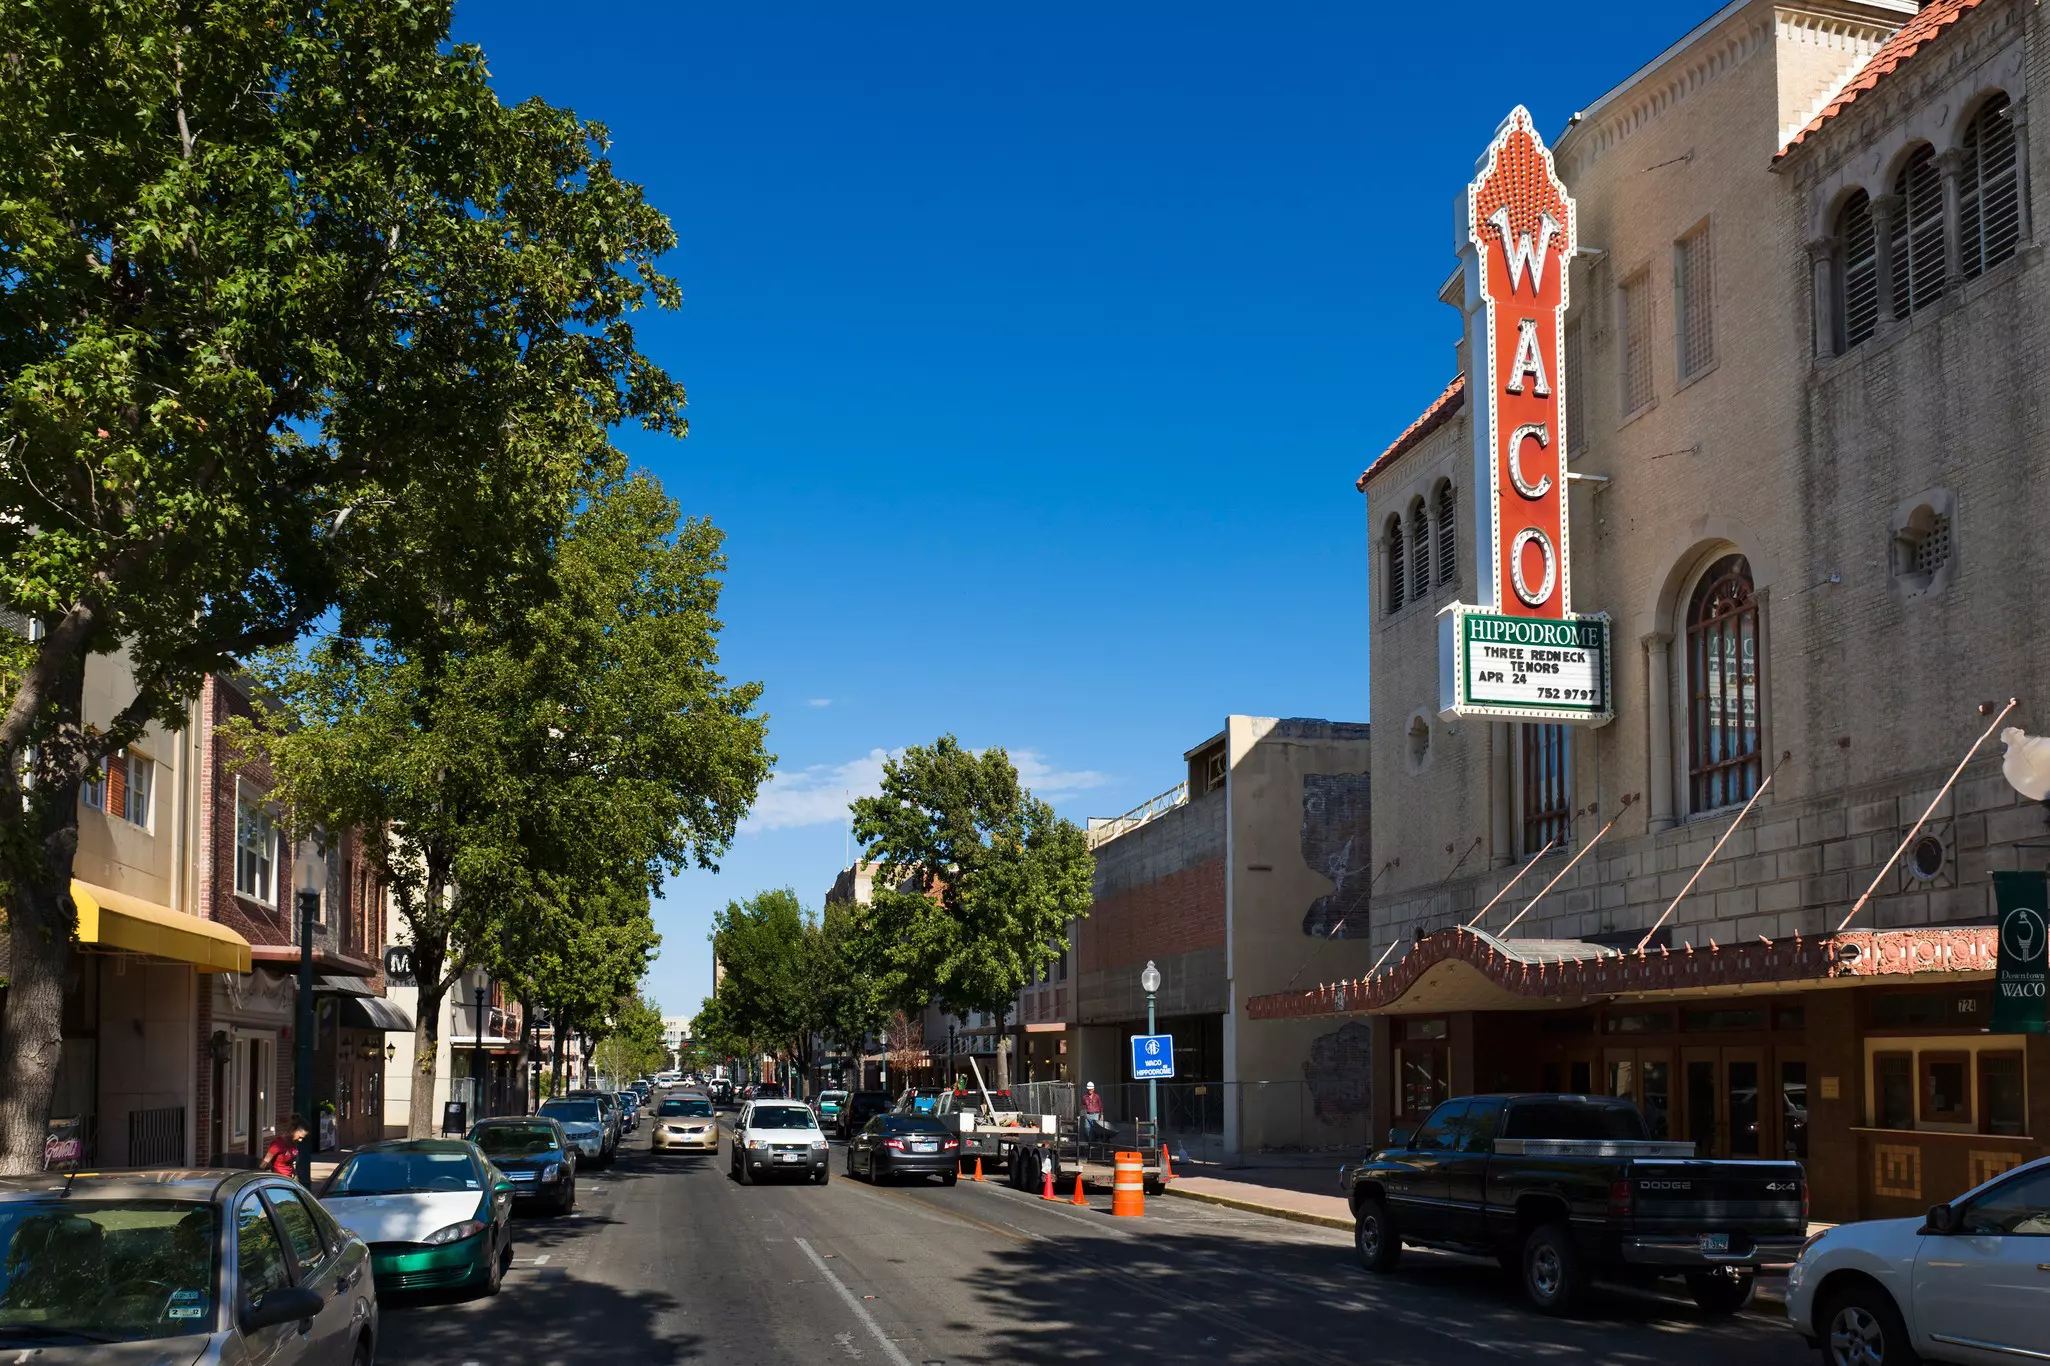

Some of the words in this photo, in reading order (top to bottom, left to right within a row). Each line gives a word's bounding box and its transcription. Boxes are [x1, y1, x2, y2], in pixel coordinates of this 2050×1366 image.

[1486, 204, 1562, 608] WACO
[1471, 620, 1599, 646] HIPPODROME
[1484, 646, 1524, 659] THREE
[1531, 650, 1586, 663] REDNECK
[1510, 661, 1560, 674] TENORS
[1479, 671, 1504, 683] APR
[1512, 674, 1527, 684] 24
[1538, 687, 1560, 699] 752
[1564, 689, 1597, 700] 9797
[2001, 970, 2045, 979] Downtown
[385, 979, 417, 987] METRO
[2000, 982, 2046, 997] WACO
[1959, 999, 1976, 1012] 724
[1144, 1059, 1162, 1067] WACO
[1136, 1068, 1172, 1077] HIPPODROME
[1640, 1181, 1691, 1190] DODGE
